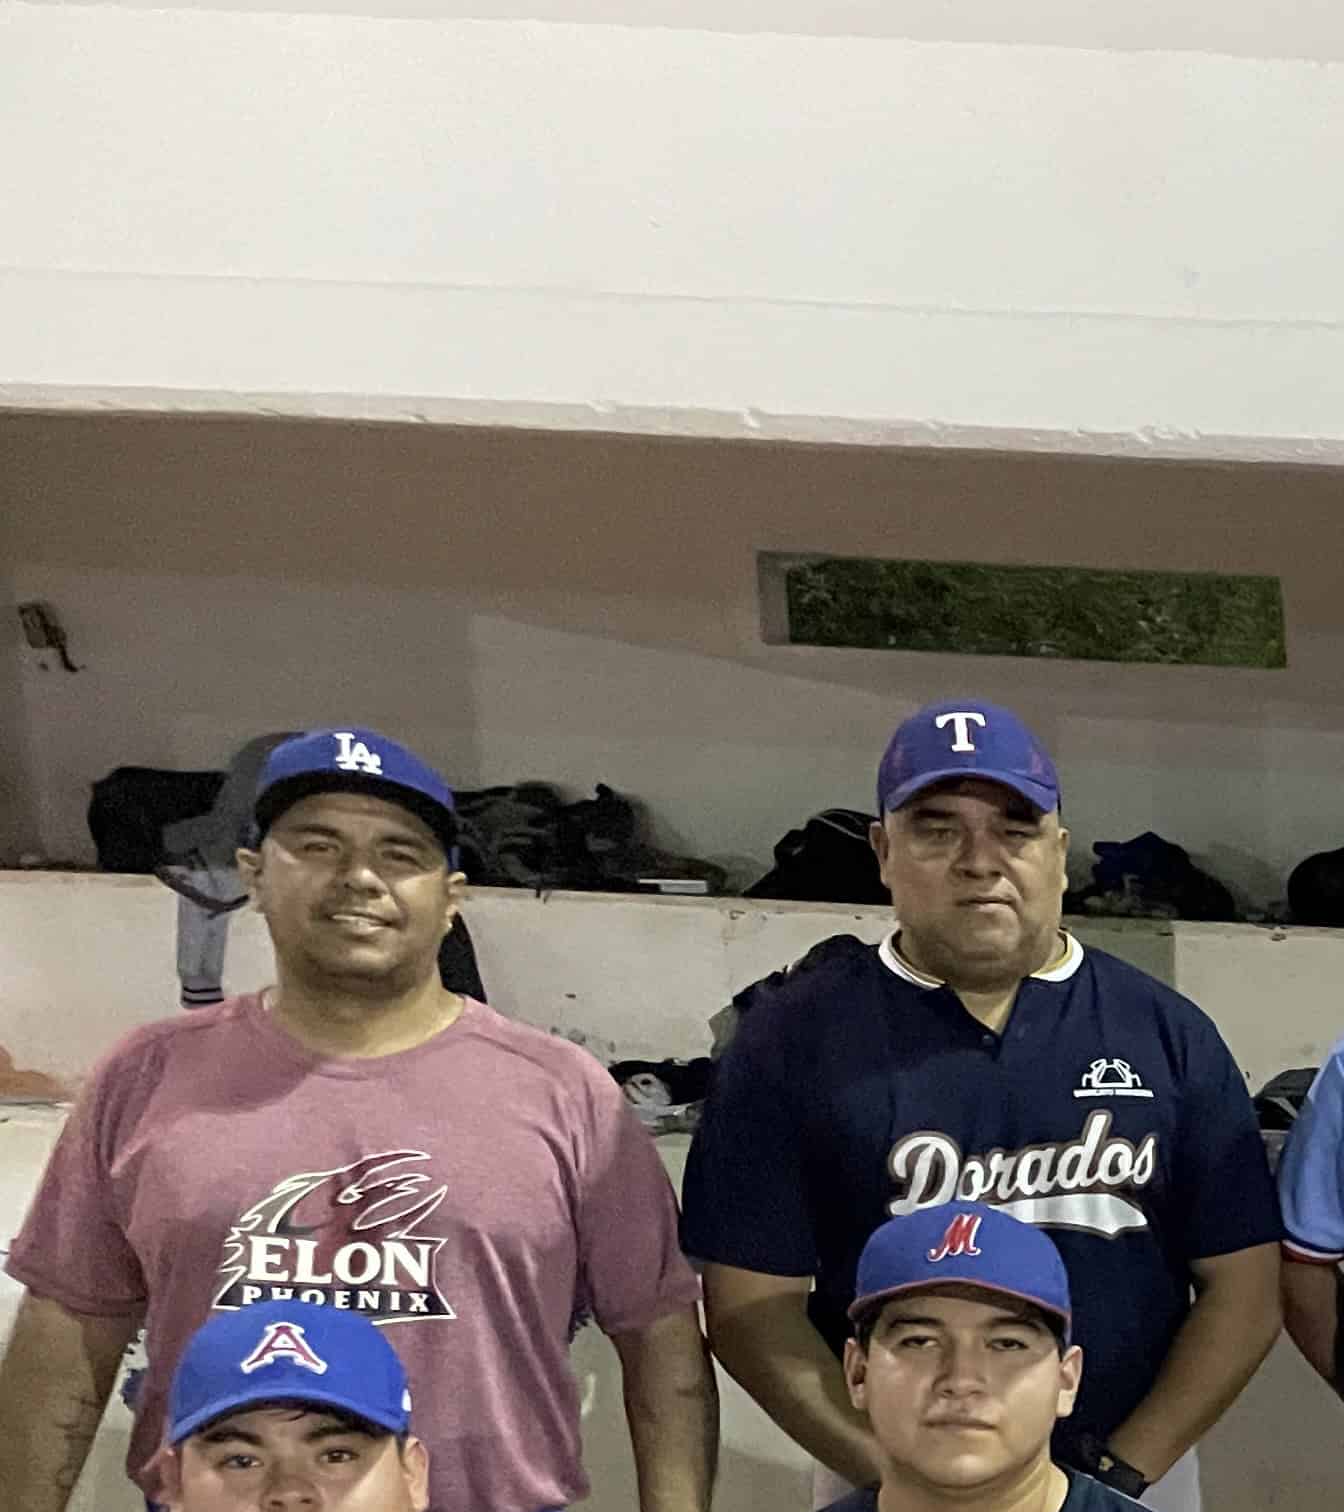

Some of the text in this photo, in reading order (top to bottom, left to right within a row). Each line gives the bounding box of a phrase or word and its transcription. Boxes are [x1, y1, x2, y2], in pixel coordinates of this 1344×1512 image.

[333, 732, 384, 776] LA
[935, 711, 987, 753] T
[889, 1111, 1157, 1217] Dorados
[247, 1235, 432, 1287] ELON
[928, 1212, 982, 1262] M
[241, 1285, 430, 1313] PHOENIX
[240, 1321, 328, 1376] A
